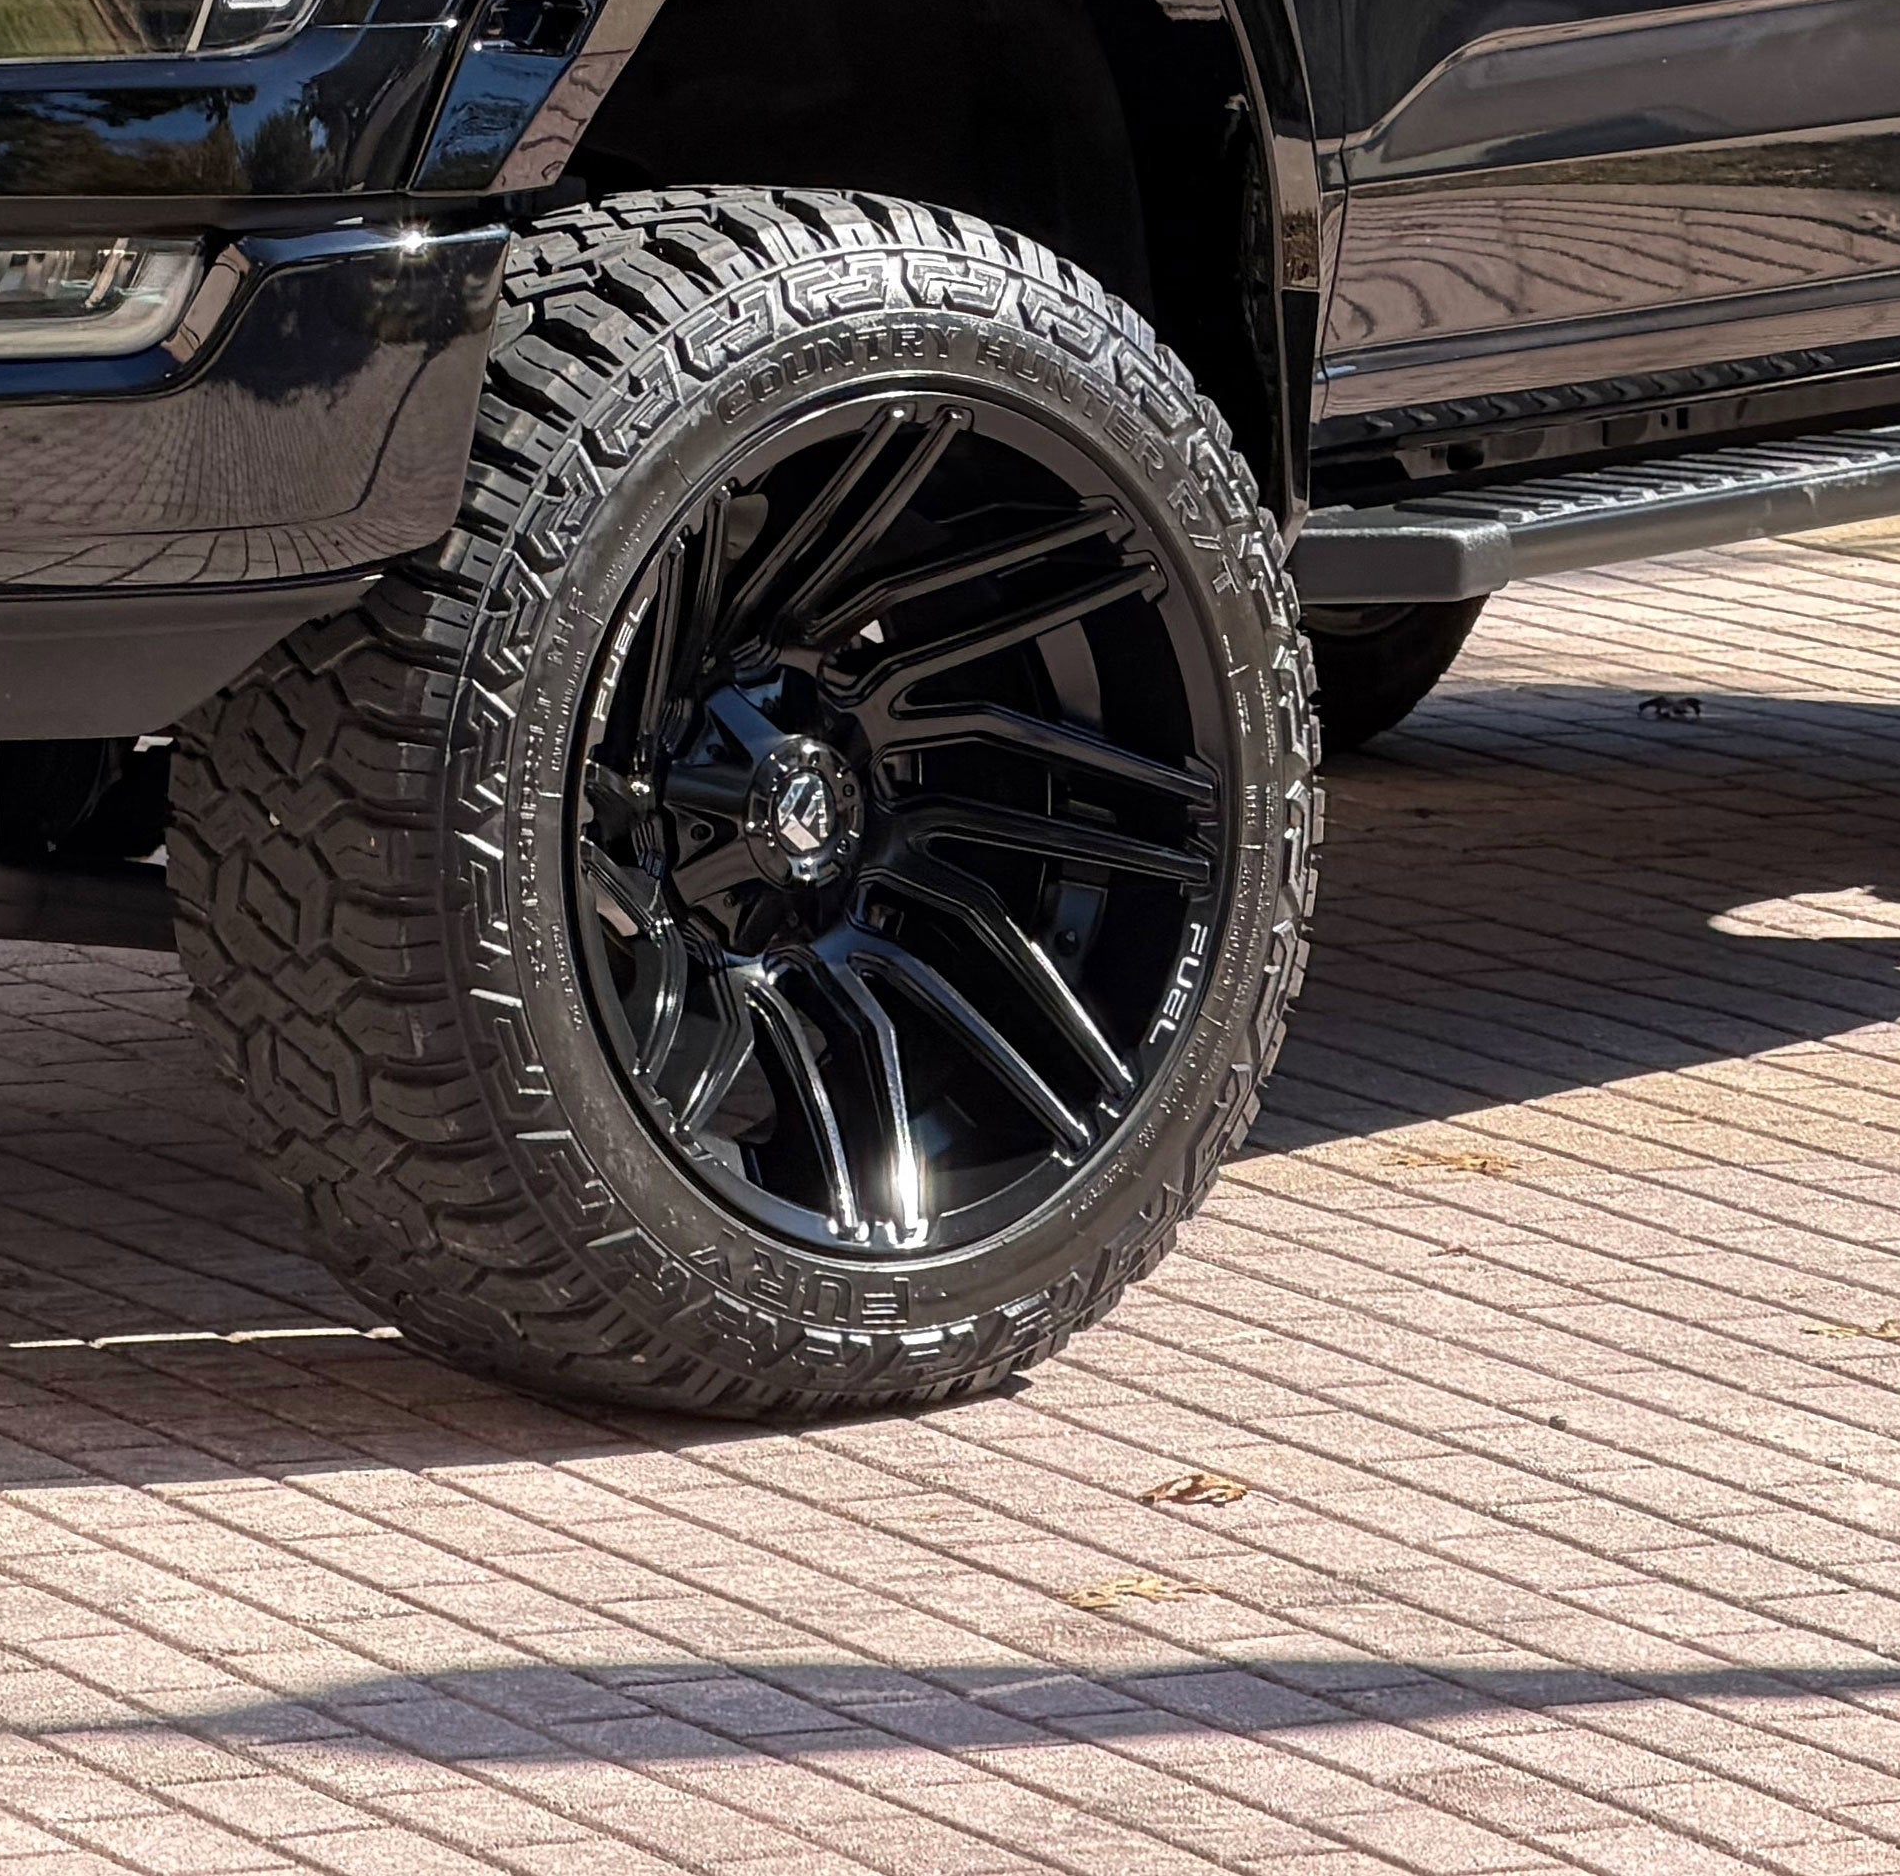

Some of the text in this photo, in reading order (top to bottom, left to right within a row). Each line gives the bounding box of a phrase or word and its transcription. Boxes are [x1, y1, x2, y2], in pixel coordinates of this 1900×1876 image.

[715, 322, 1242, 596] COUNTRY HUNTER R/T
[592, 597, 649, 722] FUEL
[1148, 922, 1209, 1044] FUEL
[687, 1226, 910, 1325] FURY
